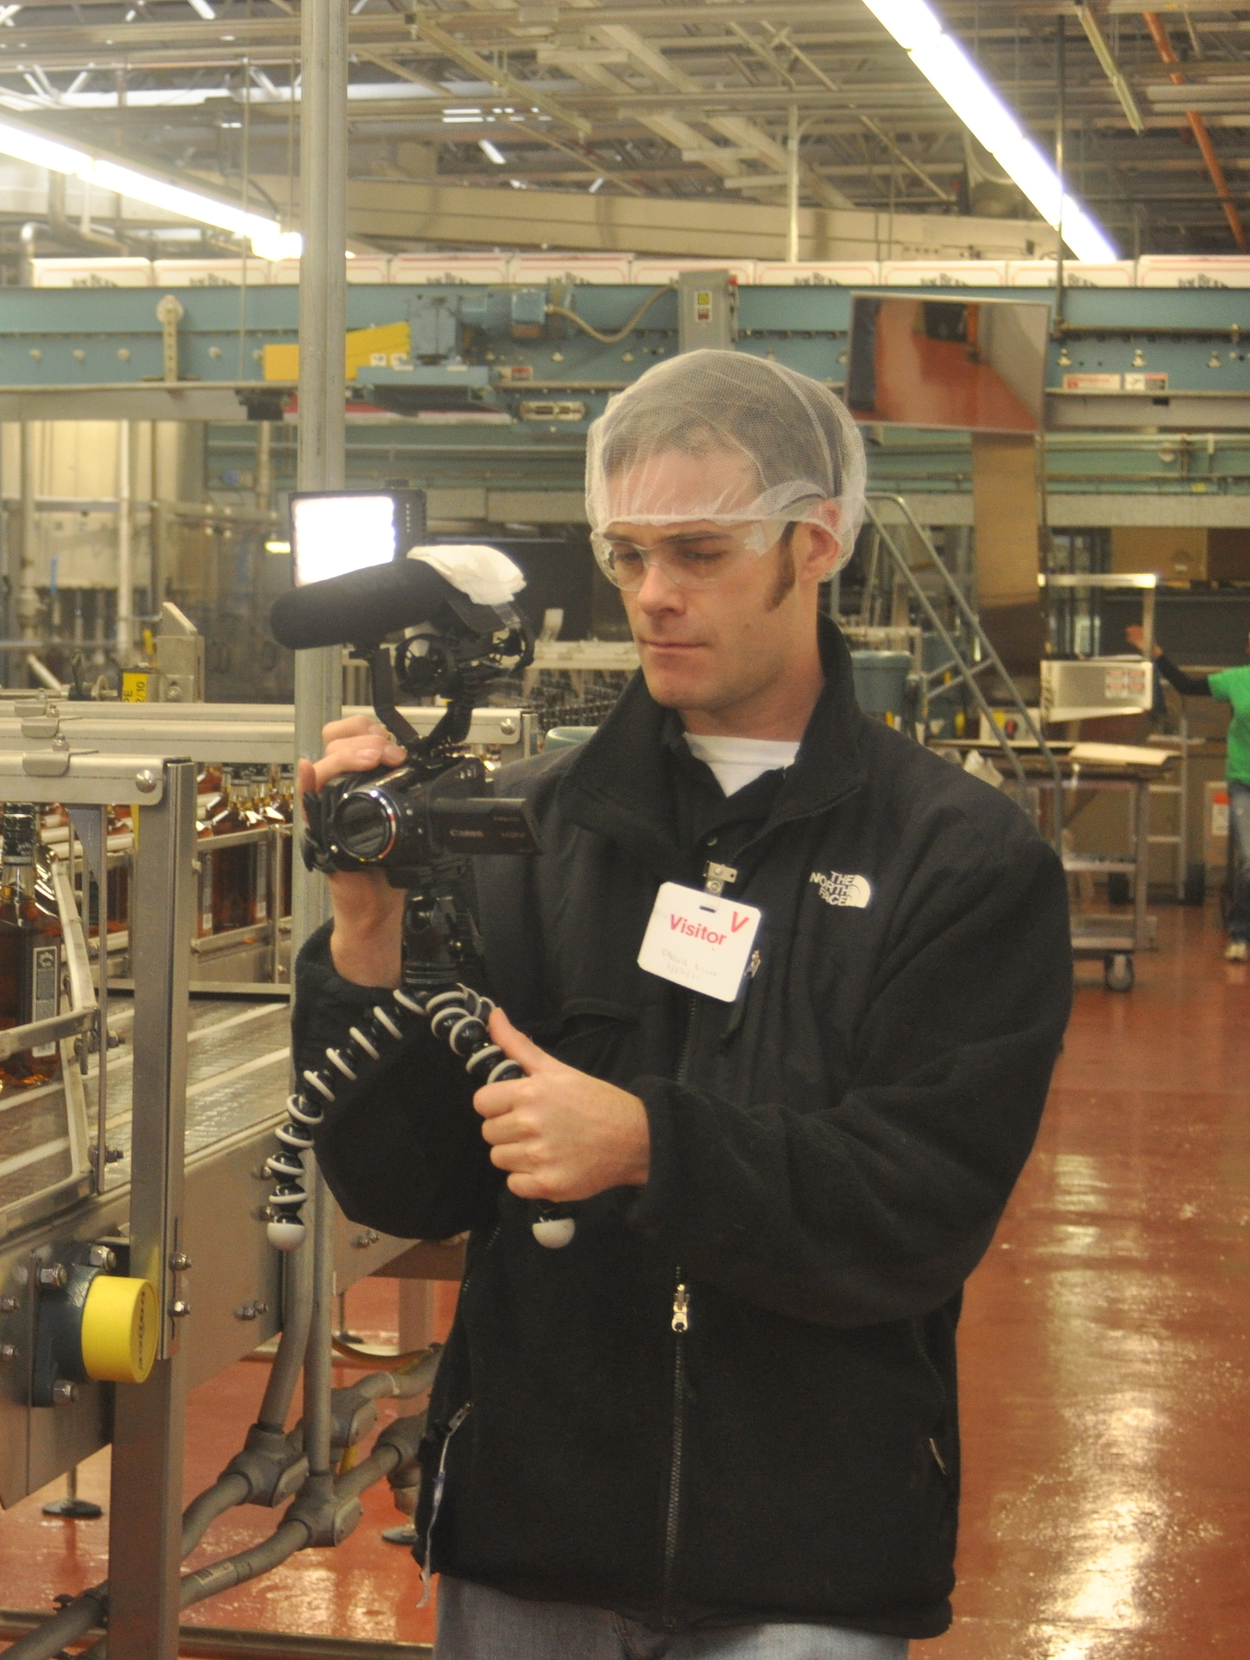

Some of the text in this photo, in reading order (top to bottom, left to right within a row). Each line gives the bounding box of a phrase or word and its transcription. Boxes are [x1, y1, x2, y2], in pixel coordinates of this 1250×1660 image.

[809, 871, 849, 896] NORTH
[830, 870, 854, 886] THE
[818, 886, 848, 907] FACE
[670, 913, 727, 945] Visitor
[730, 910, 750, 934] V
